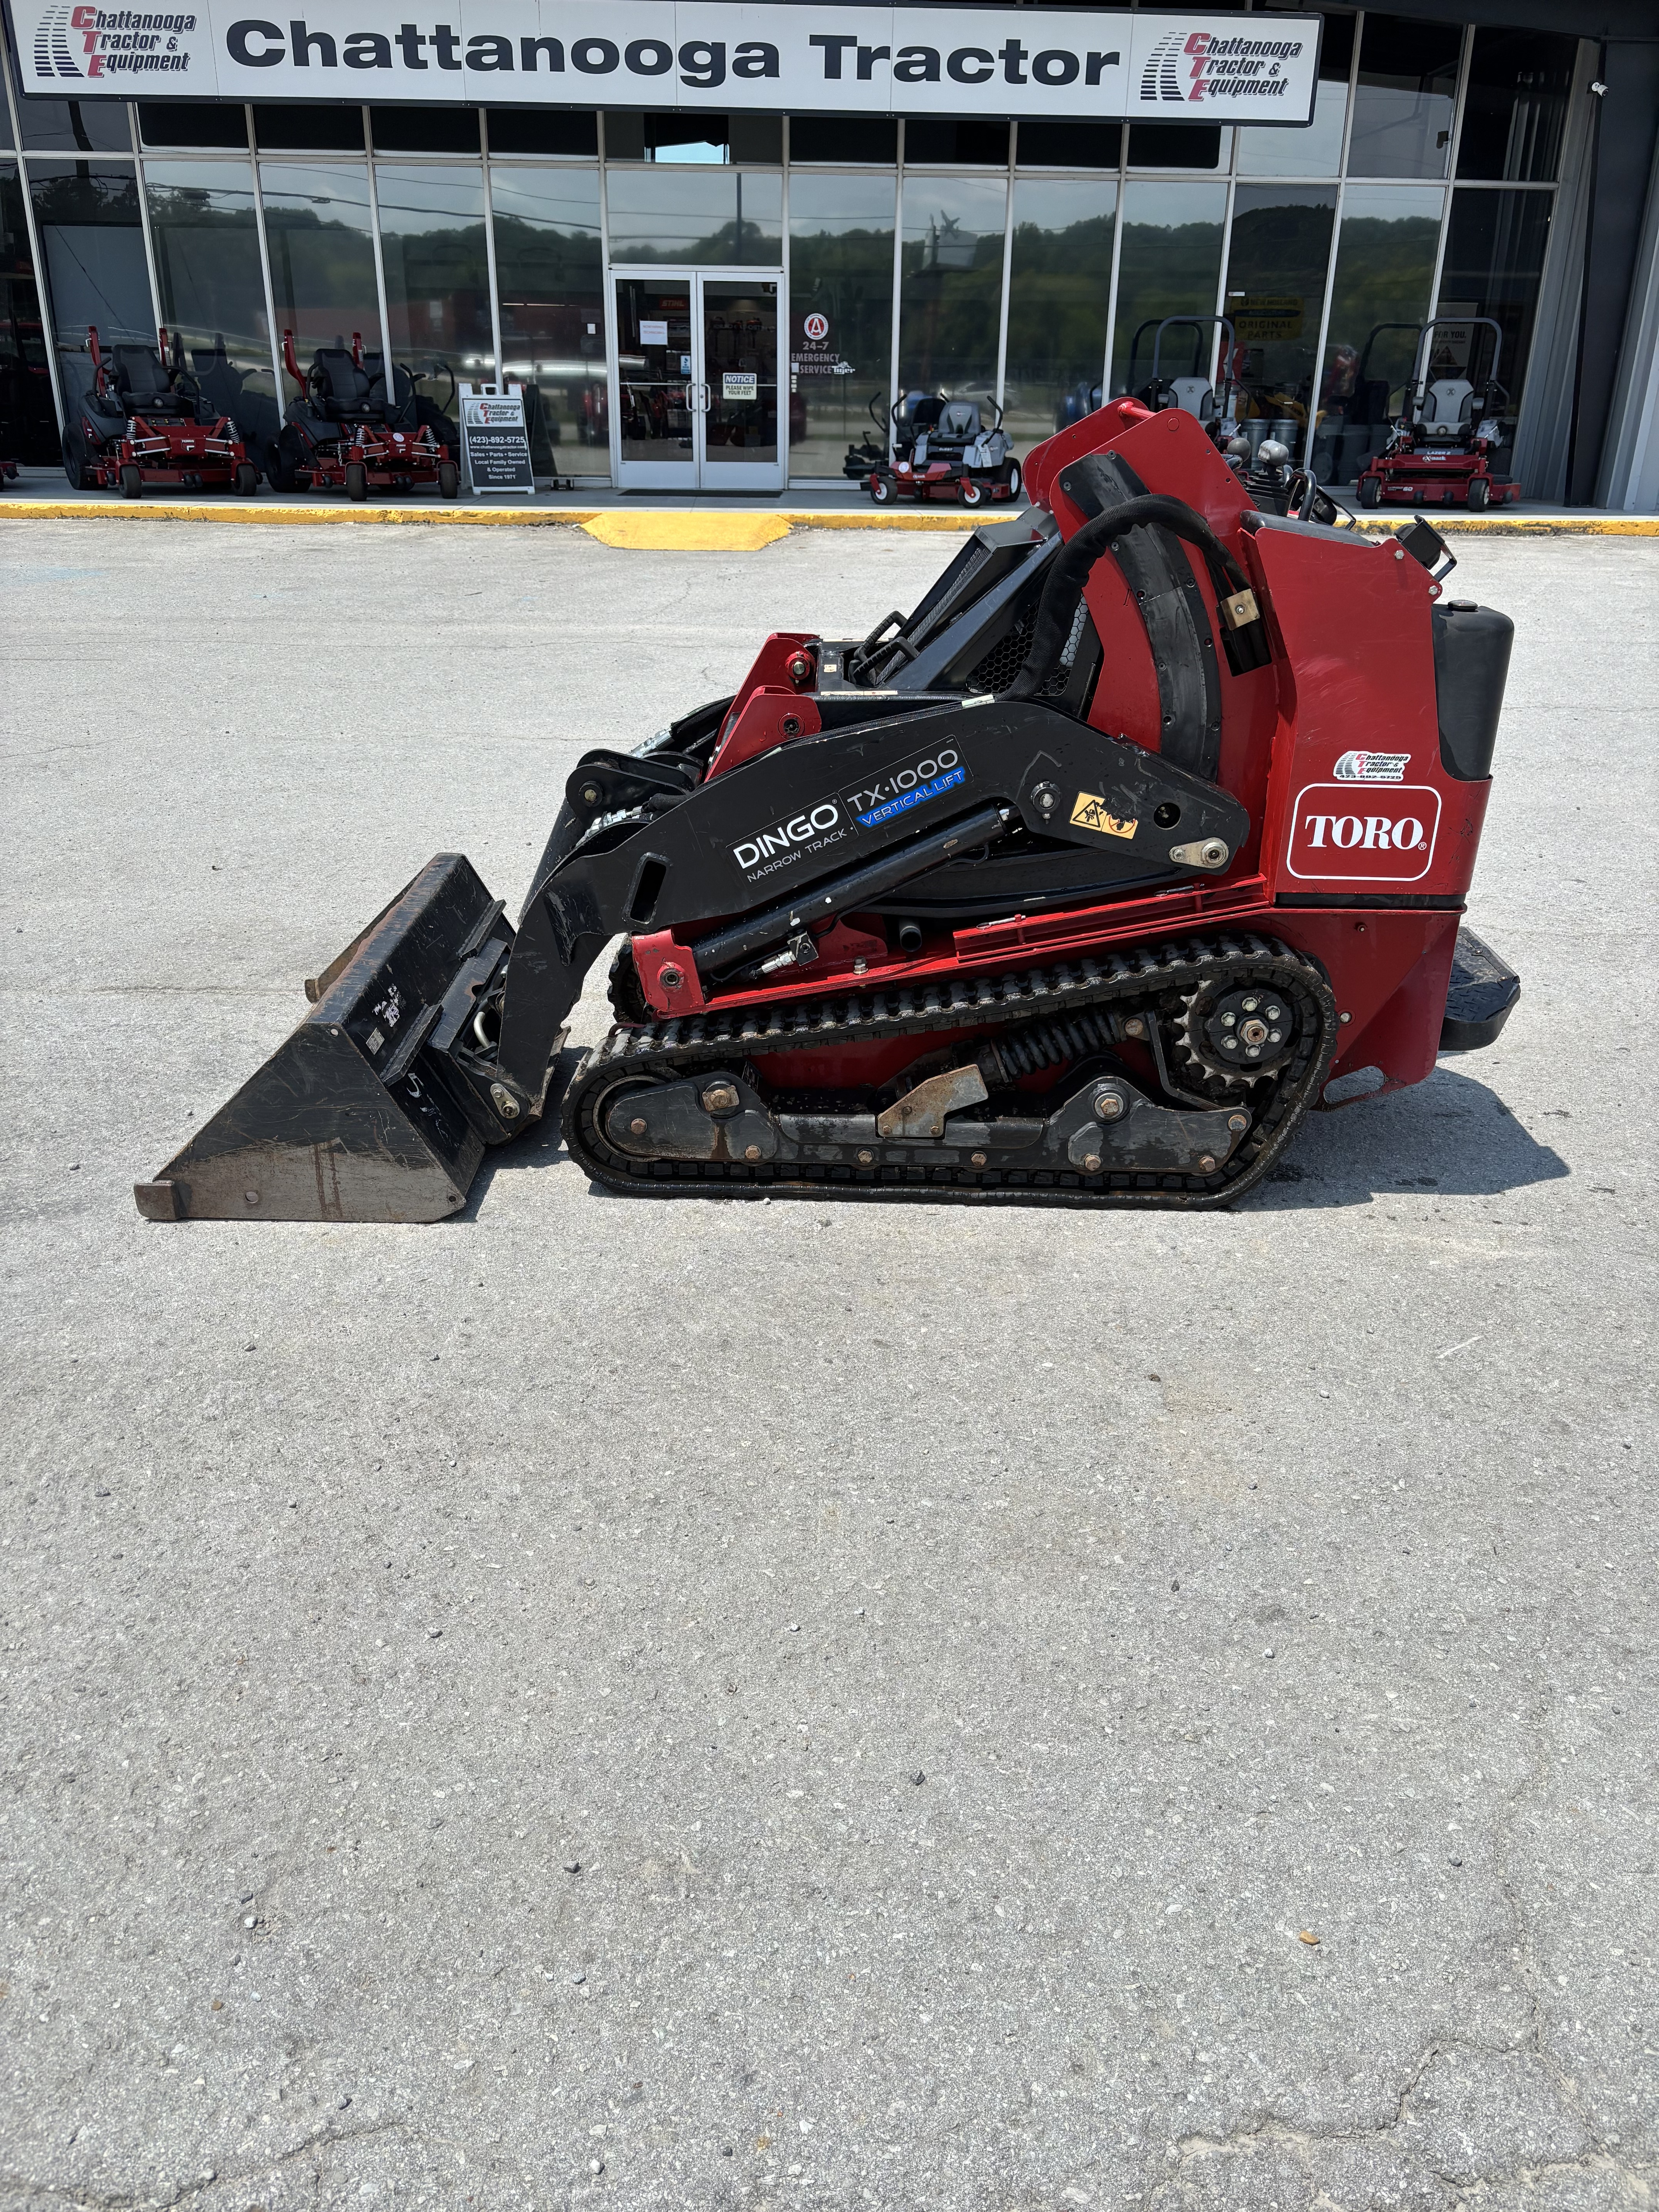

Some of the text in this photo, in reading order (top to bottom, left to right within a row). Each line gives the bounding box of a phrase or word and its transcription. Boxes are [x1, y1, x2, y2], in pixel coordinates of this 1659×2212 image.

[71, 6, 197, 34] Chattanooga
[82, 31, 178, 53] Tractor &
[1184, 33, 1304, 60] Chattanooga
[87, 52, 190, 78] Equipment
[226, 20, 1120, 88] Chattanooga Tractor
[1190, 57, 1280, 78] Tractor &
[1188, 79, 1289, 102] Equipment
[1239, 321, 1293, 329] ORIGINAL
[1248, 331, 1282, 339] PARTS
[791, 353, 840, 362] EMERGENCY
[800, 365, 832, 374] SERVICE
[469, 436, 525, 445] (423)-892-5725
[1355, 753, 1409, 762] Chattanooga
[861, 770, 963, 826] VERTICAL LIFT
[733, 804, 839, 869] DINGO
[747, 828, 847, 883] NARROW TRACK
